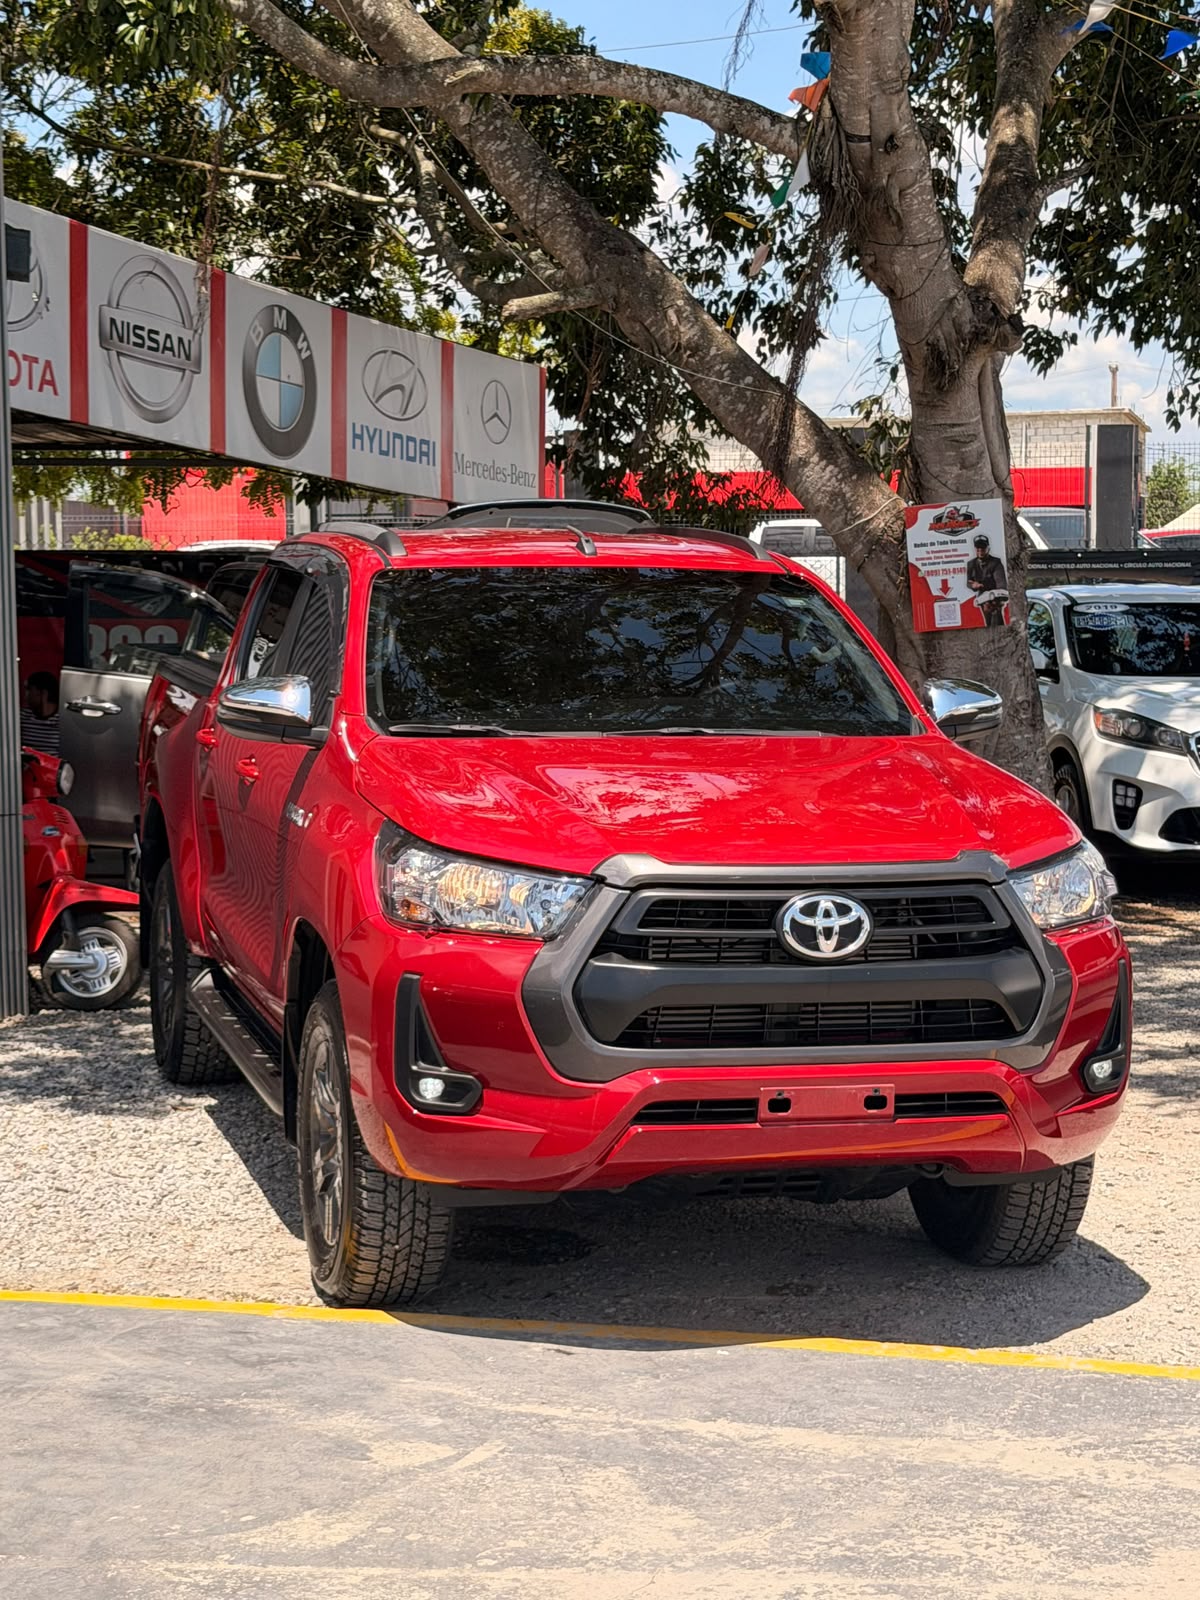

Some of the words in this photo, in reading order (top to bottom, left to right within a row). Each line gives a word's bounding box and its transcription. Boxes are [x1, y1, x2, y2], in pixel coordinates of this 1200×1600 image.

[109, 317, 191, 361] NISSAN
[249, 306, 311, 360] BMW
[8, 349, 59, 396] OTA
[352, 422, 436, 467] HYUNDAI
[454, 452, 536, 488] Mercedes-Benz
